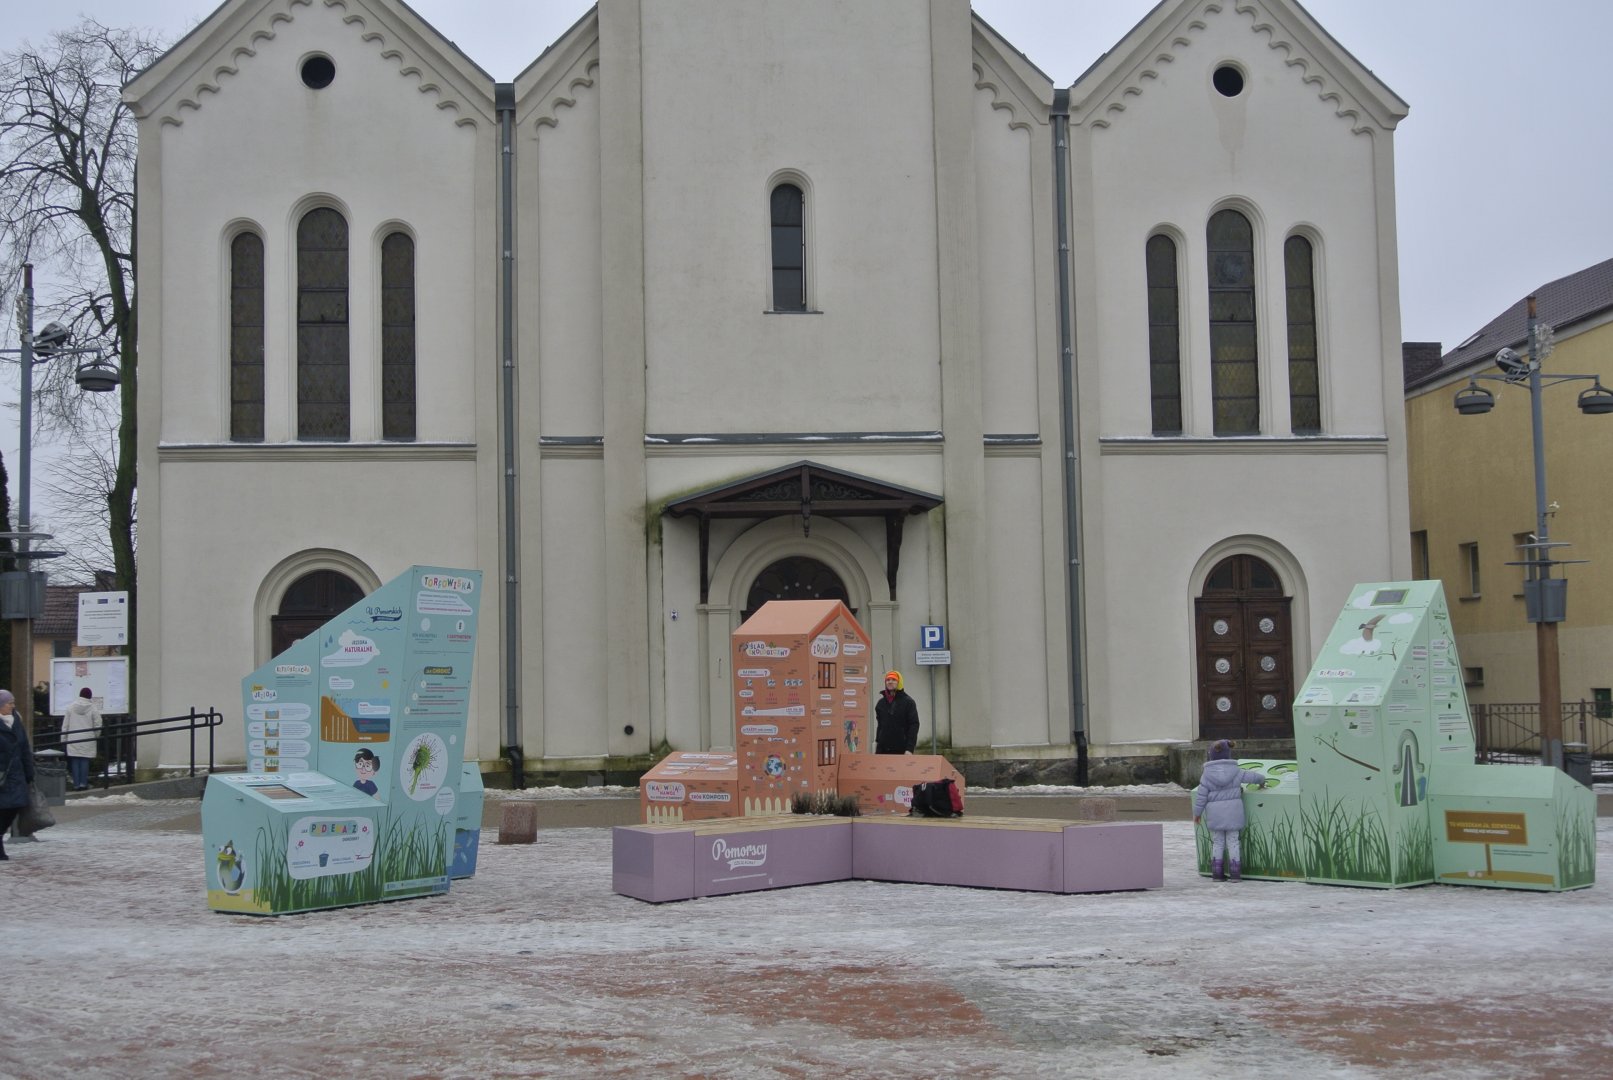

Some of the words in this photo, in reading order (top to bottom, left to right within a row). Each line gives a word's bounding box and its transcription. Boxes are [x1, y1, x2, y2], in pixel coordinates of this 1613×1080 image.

[424, 576, 472, 590] TORFOWISKA
[924, 627, 940, 647] P
[712, 838, 767, 861] Pomorscy
